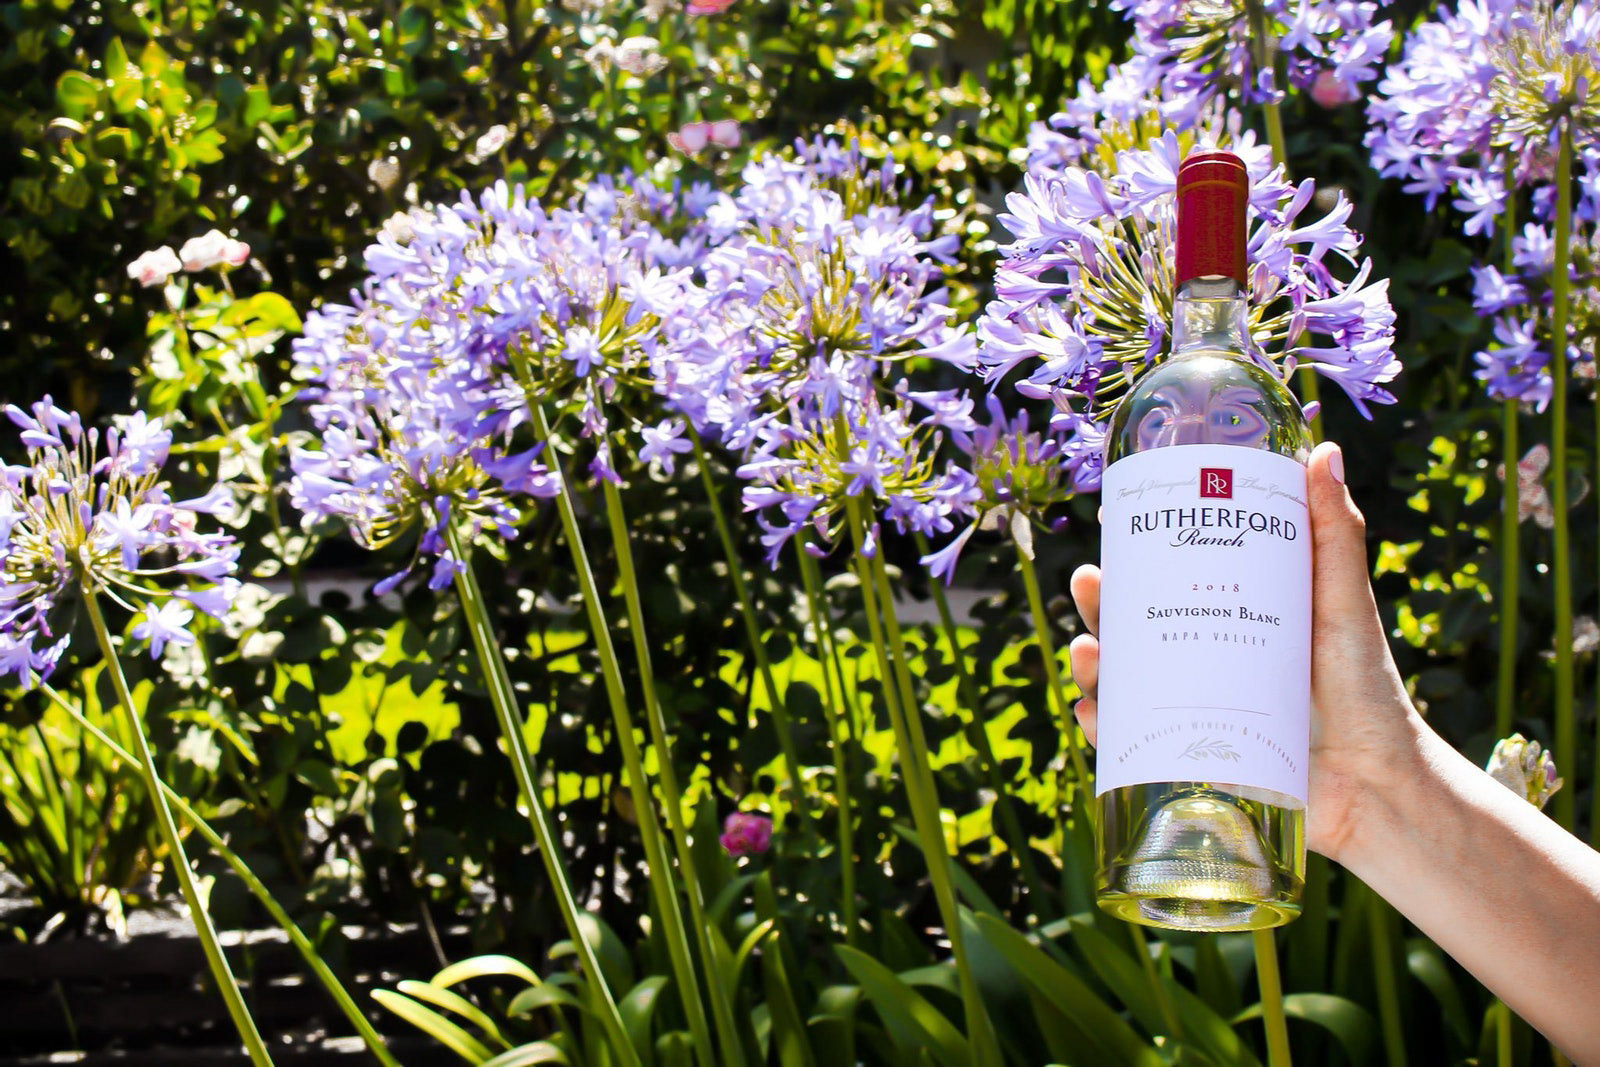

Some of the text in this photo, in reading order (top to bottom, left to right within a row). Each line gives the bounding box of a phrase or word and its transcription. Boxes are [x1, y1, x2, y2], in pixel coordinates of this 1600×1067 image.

[1131, 507, 1297, 541] RUTHERFORD
[1169, 527, 1251, 548] Ranch
[1161, 631, 1267, 647] NAPA VALLEY
